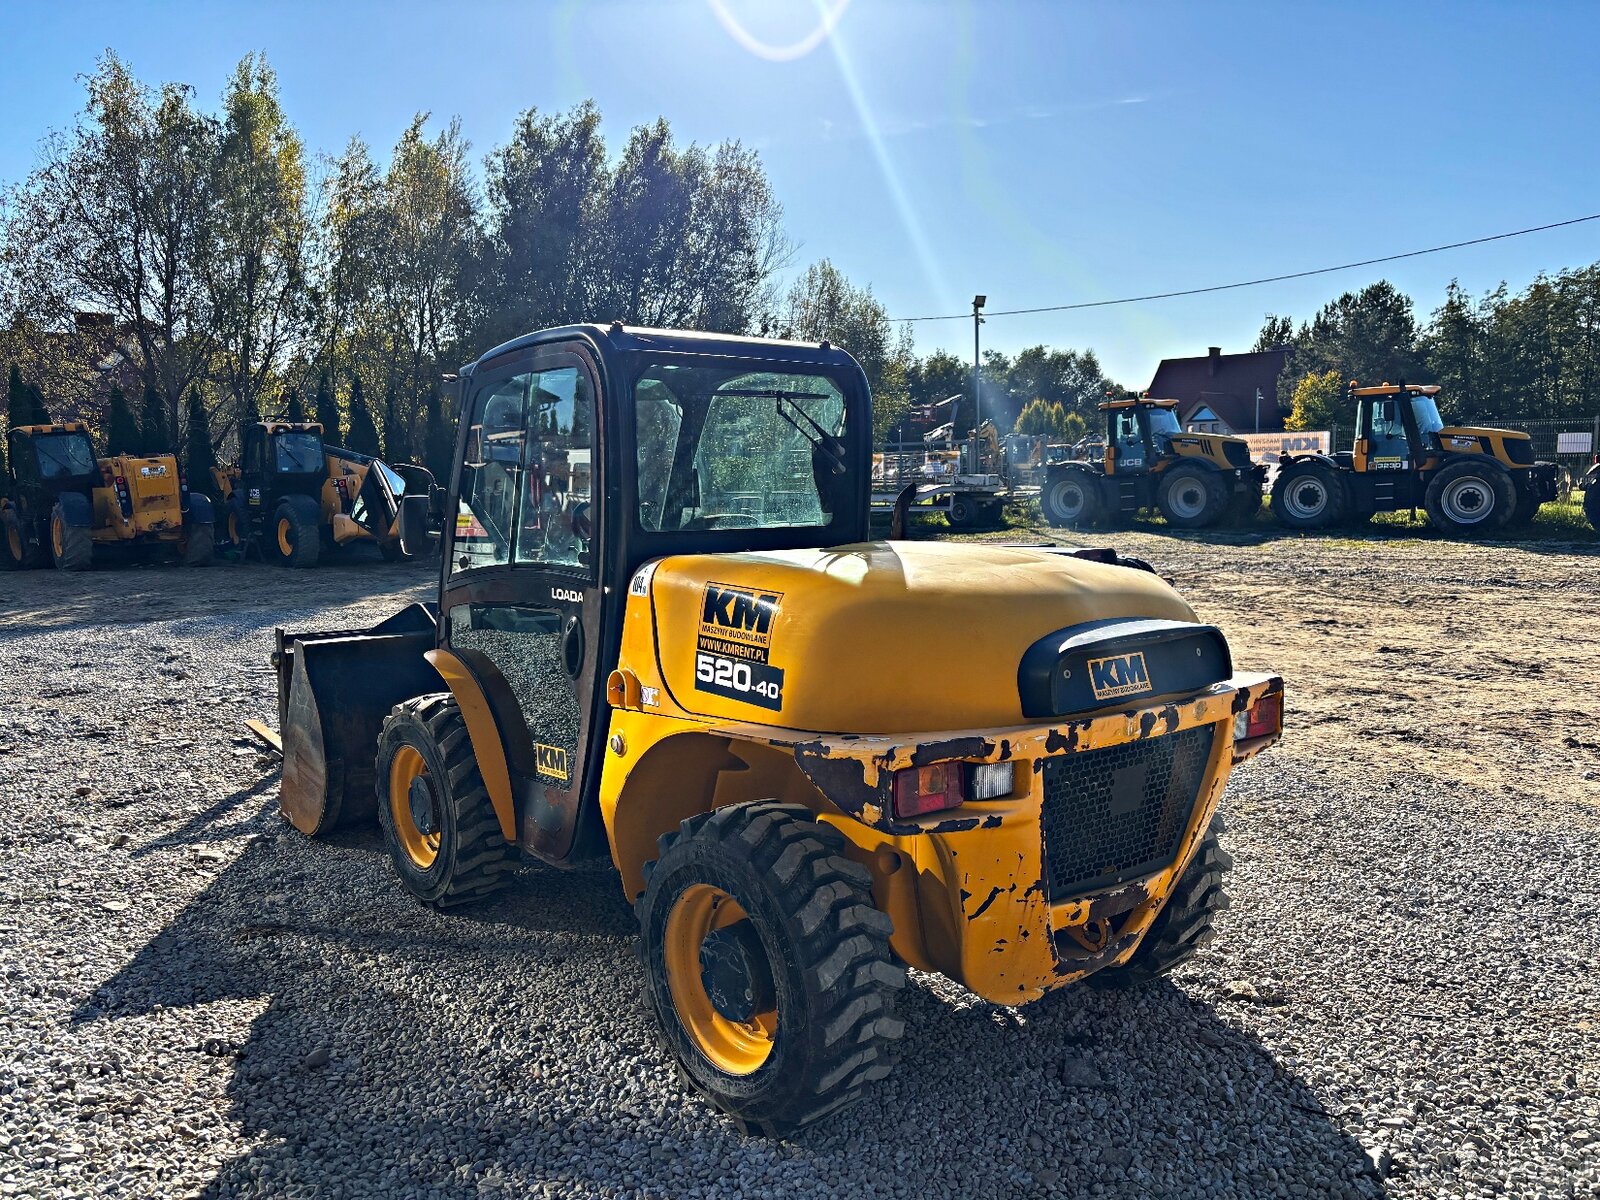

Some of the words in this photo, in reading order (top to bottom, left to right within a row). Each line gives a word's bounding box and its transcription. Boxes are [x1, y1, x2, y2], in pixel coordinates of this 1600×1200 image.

[1119, 458, 1142, 467] JCB
[703, 586, 777, 633] KM
[701, 624, 728, 638] MASZYNY
[728, 628, 767, 645] BUDOWLANE
[699, 637, 766, 661] WWW.KMRENT.PL
[1092, 655, 1146, 690] KM
[538, 746, 565, 772] KM
